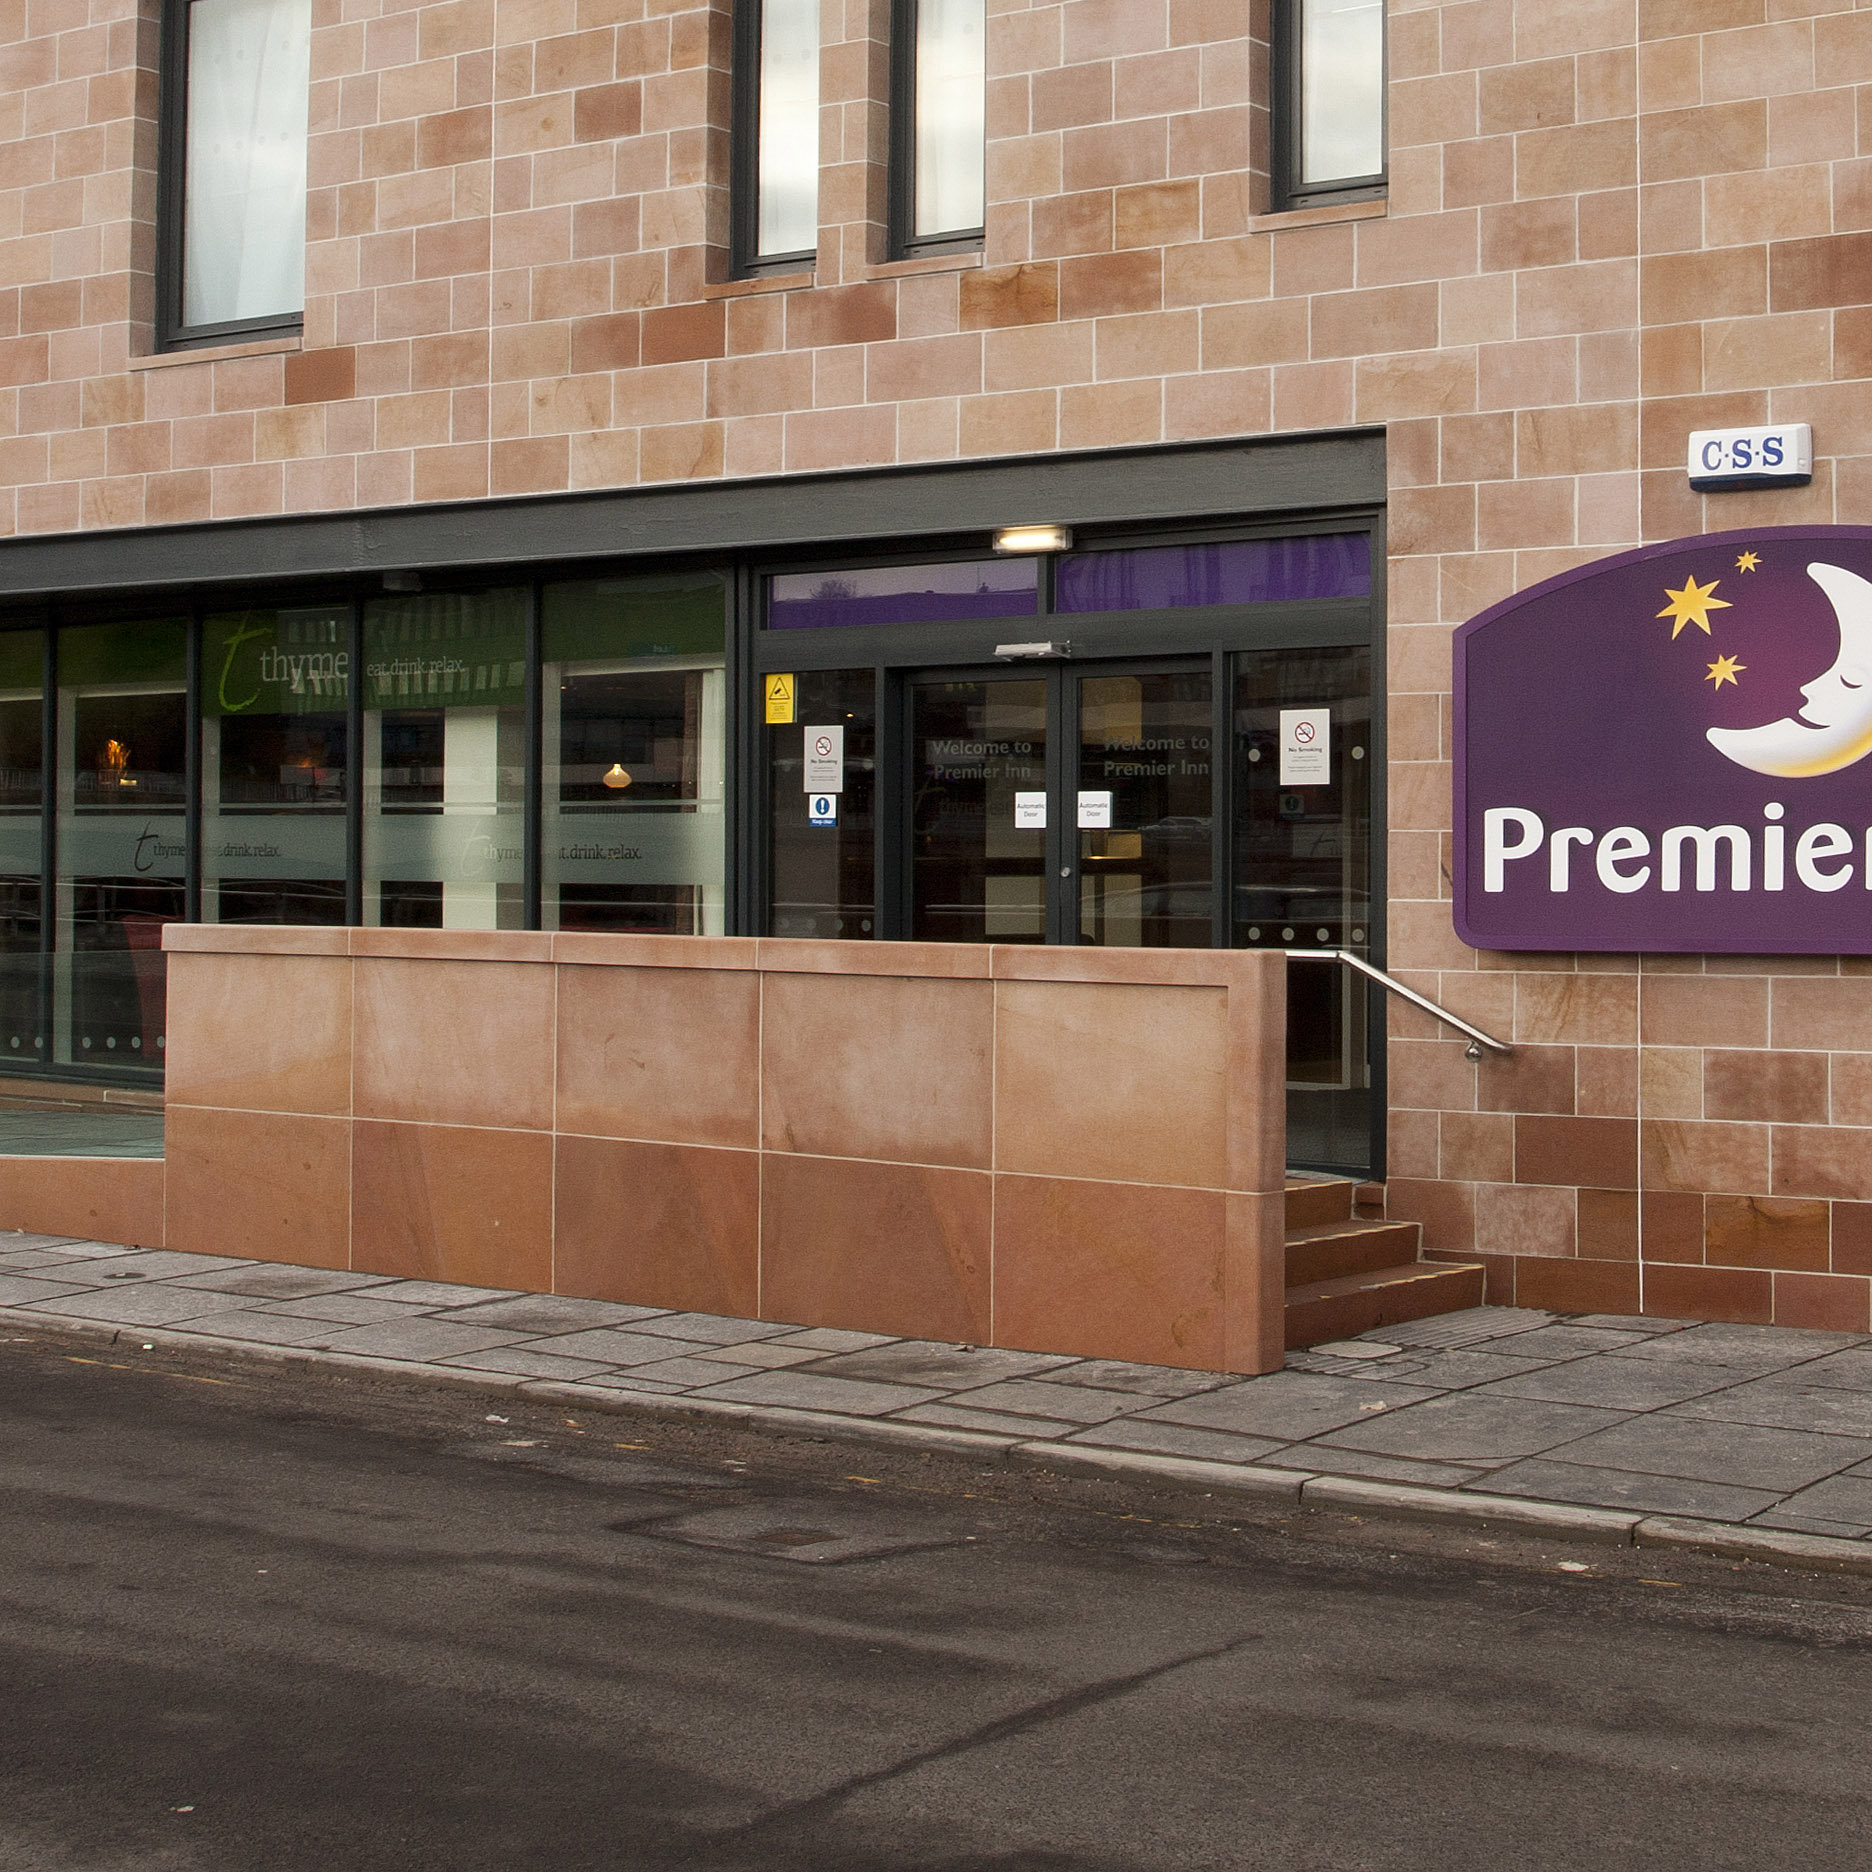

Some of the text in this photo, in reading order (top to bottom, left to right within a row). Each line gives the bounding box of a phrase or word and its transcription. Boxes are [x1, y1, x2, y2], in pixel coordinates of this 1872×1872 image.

[259, 646, 349, 691] thyme
[931, 739, 1032, 755] Welcome to
[1103, 735, 1210, 751] Welcome to
[1298, 746, 1323, 754] Smoking
[818, 758, 838, 766] Smoking
[1103, 759, 1209, 777] Premier Inn
[934, 762, 1031, 780] Premier Inn
[1086, 810, 1101, 818] Door
[154, 842, 185, 859] thyme
